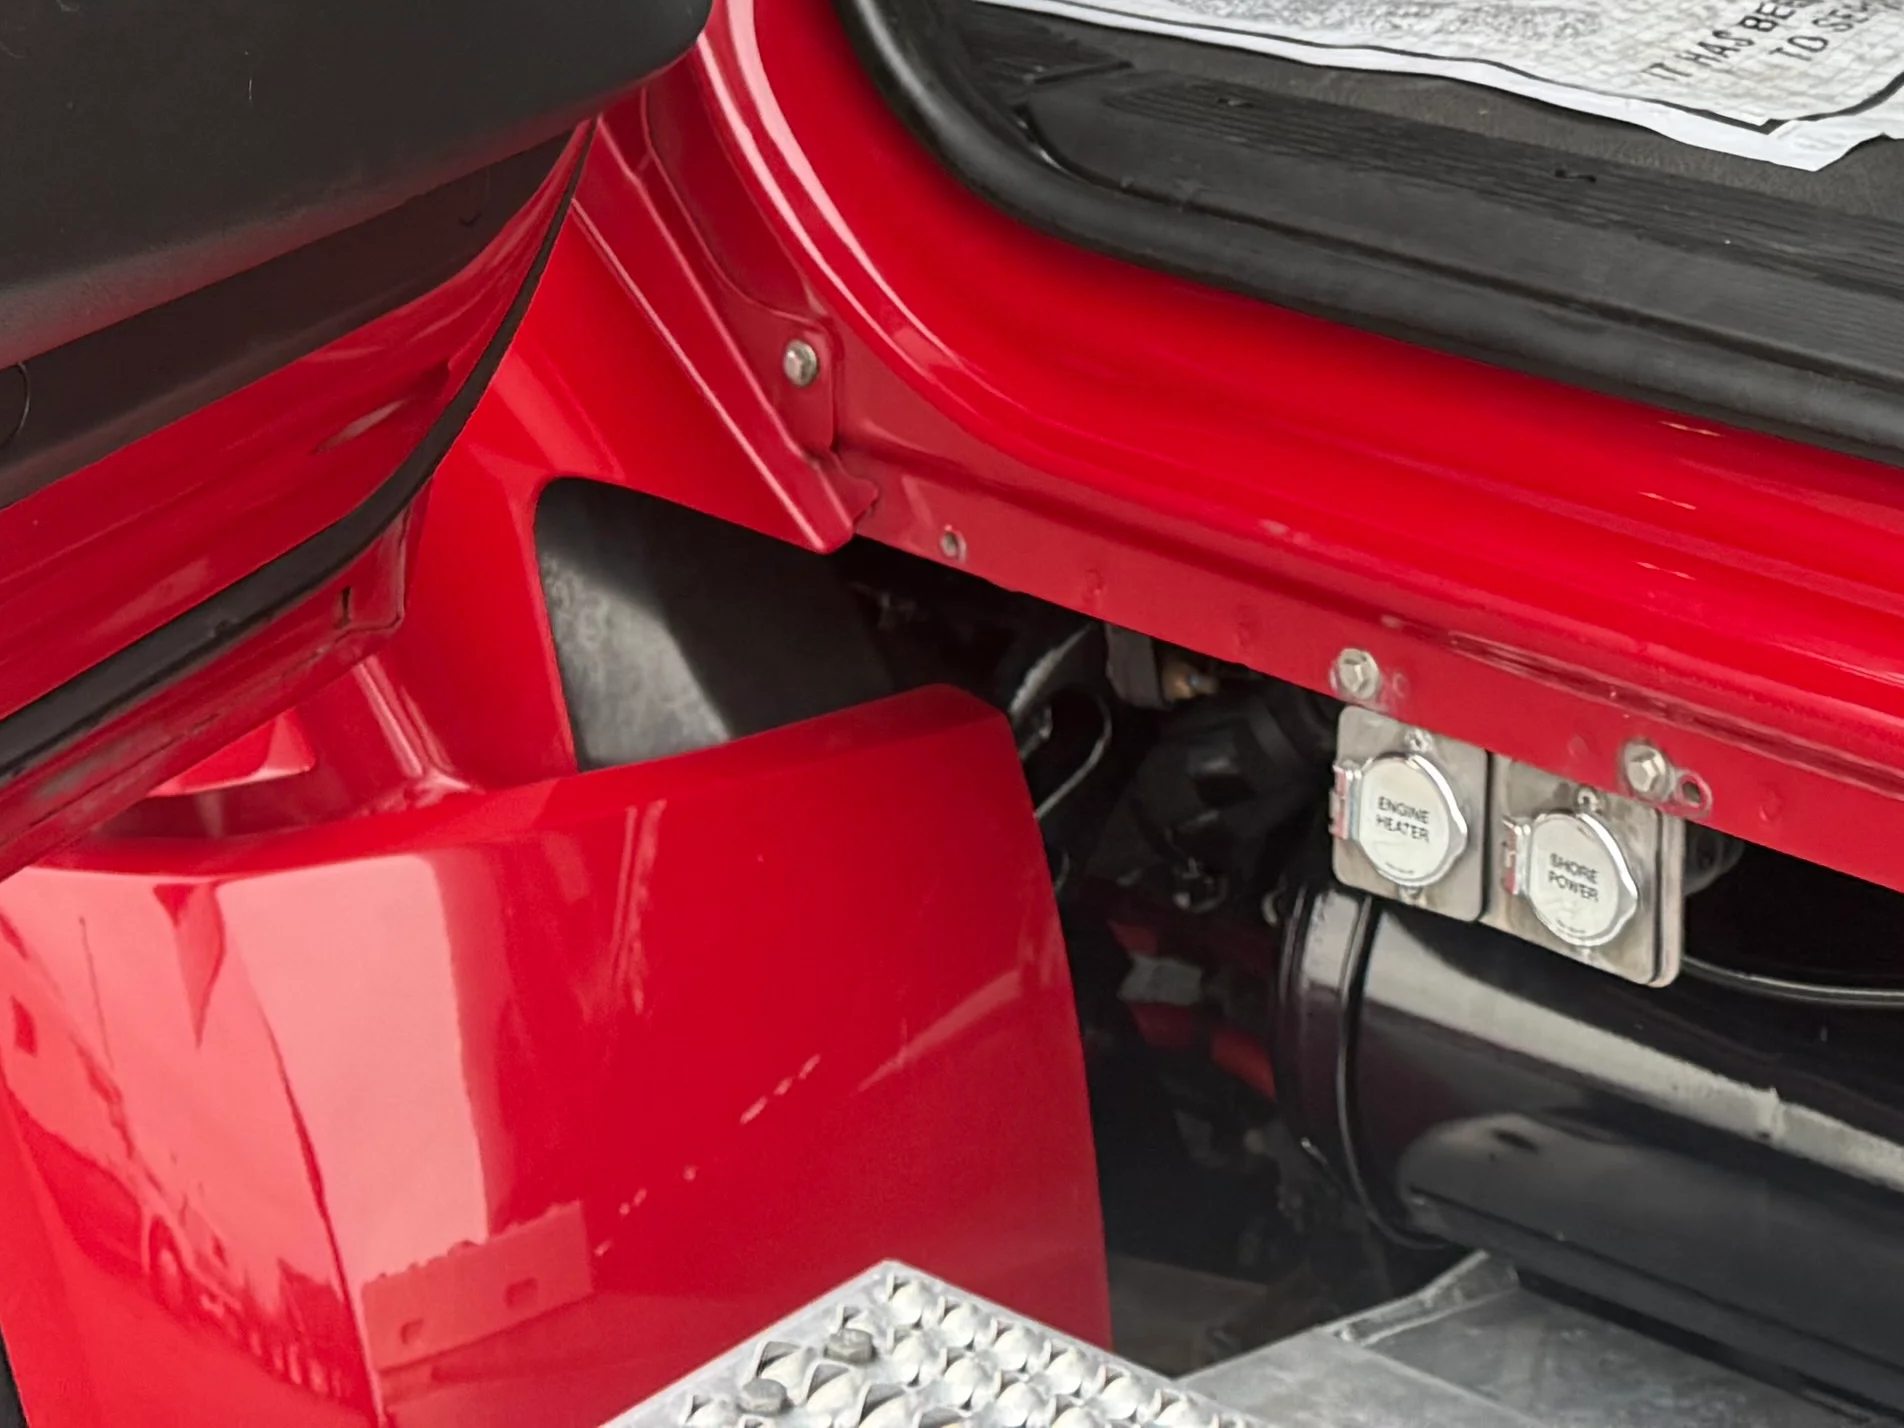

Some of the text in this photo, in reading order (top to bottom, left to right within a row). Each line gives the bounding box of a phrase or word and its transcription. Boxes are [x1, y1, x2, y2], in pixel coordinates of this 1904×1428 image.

[1640, 61, 1693, 83] IT
[1677, 28, 1755, 69] HAS
[1768, 34, 1829, 62] TO
[1377, 796, 1431, 826] ENGINE
[1375, 815, 1430, 843] HEATER
[1549, 852, 1600, 886] SHORE
[1548, 872, 1599, 903] POWER
